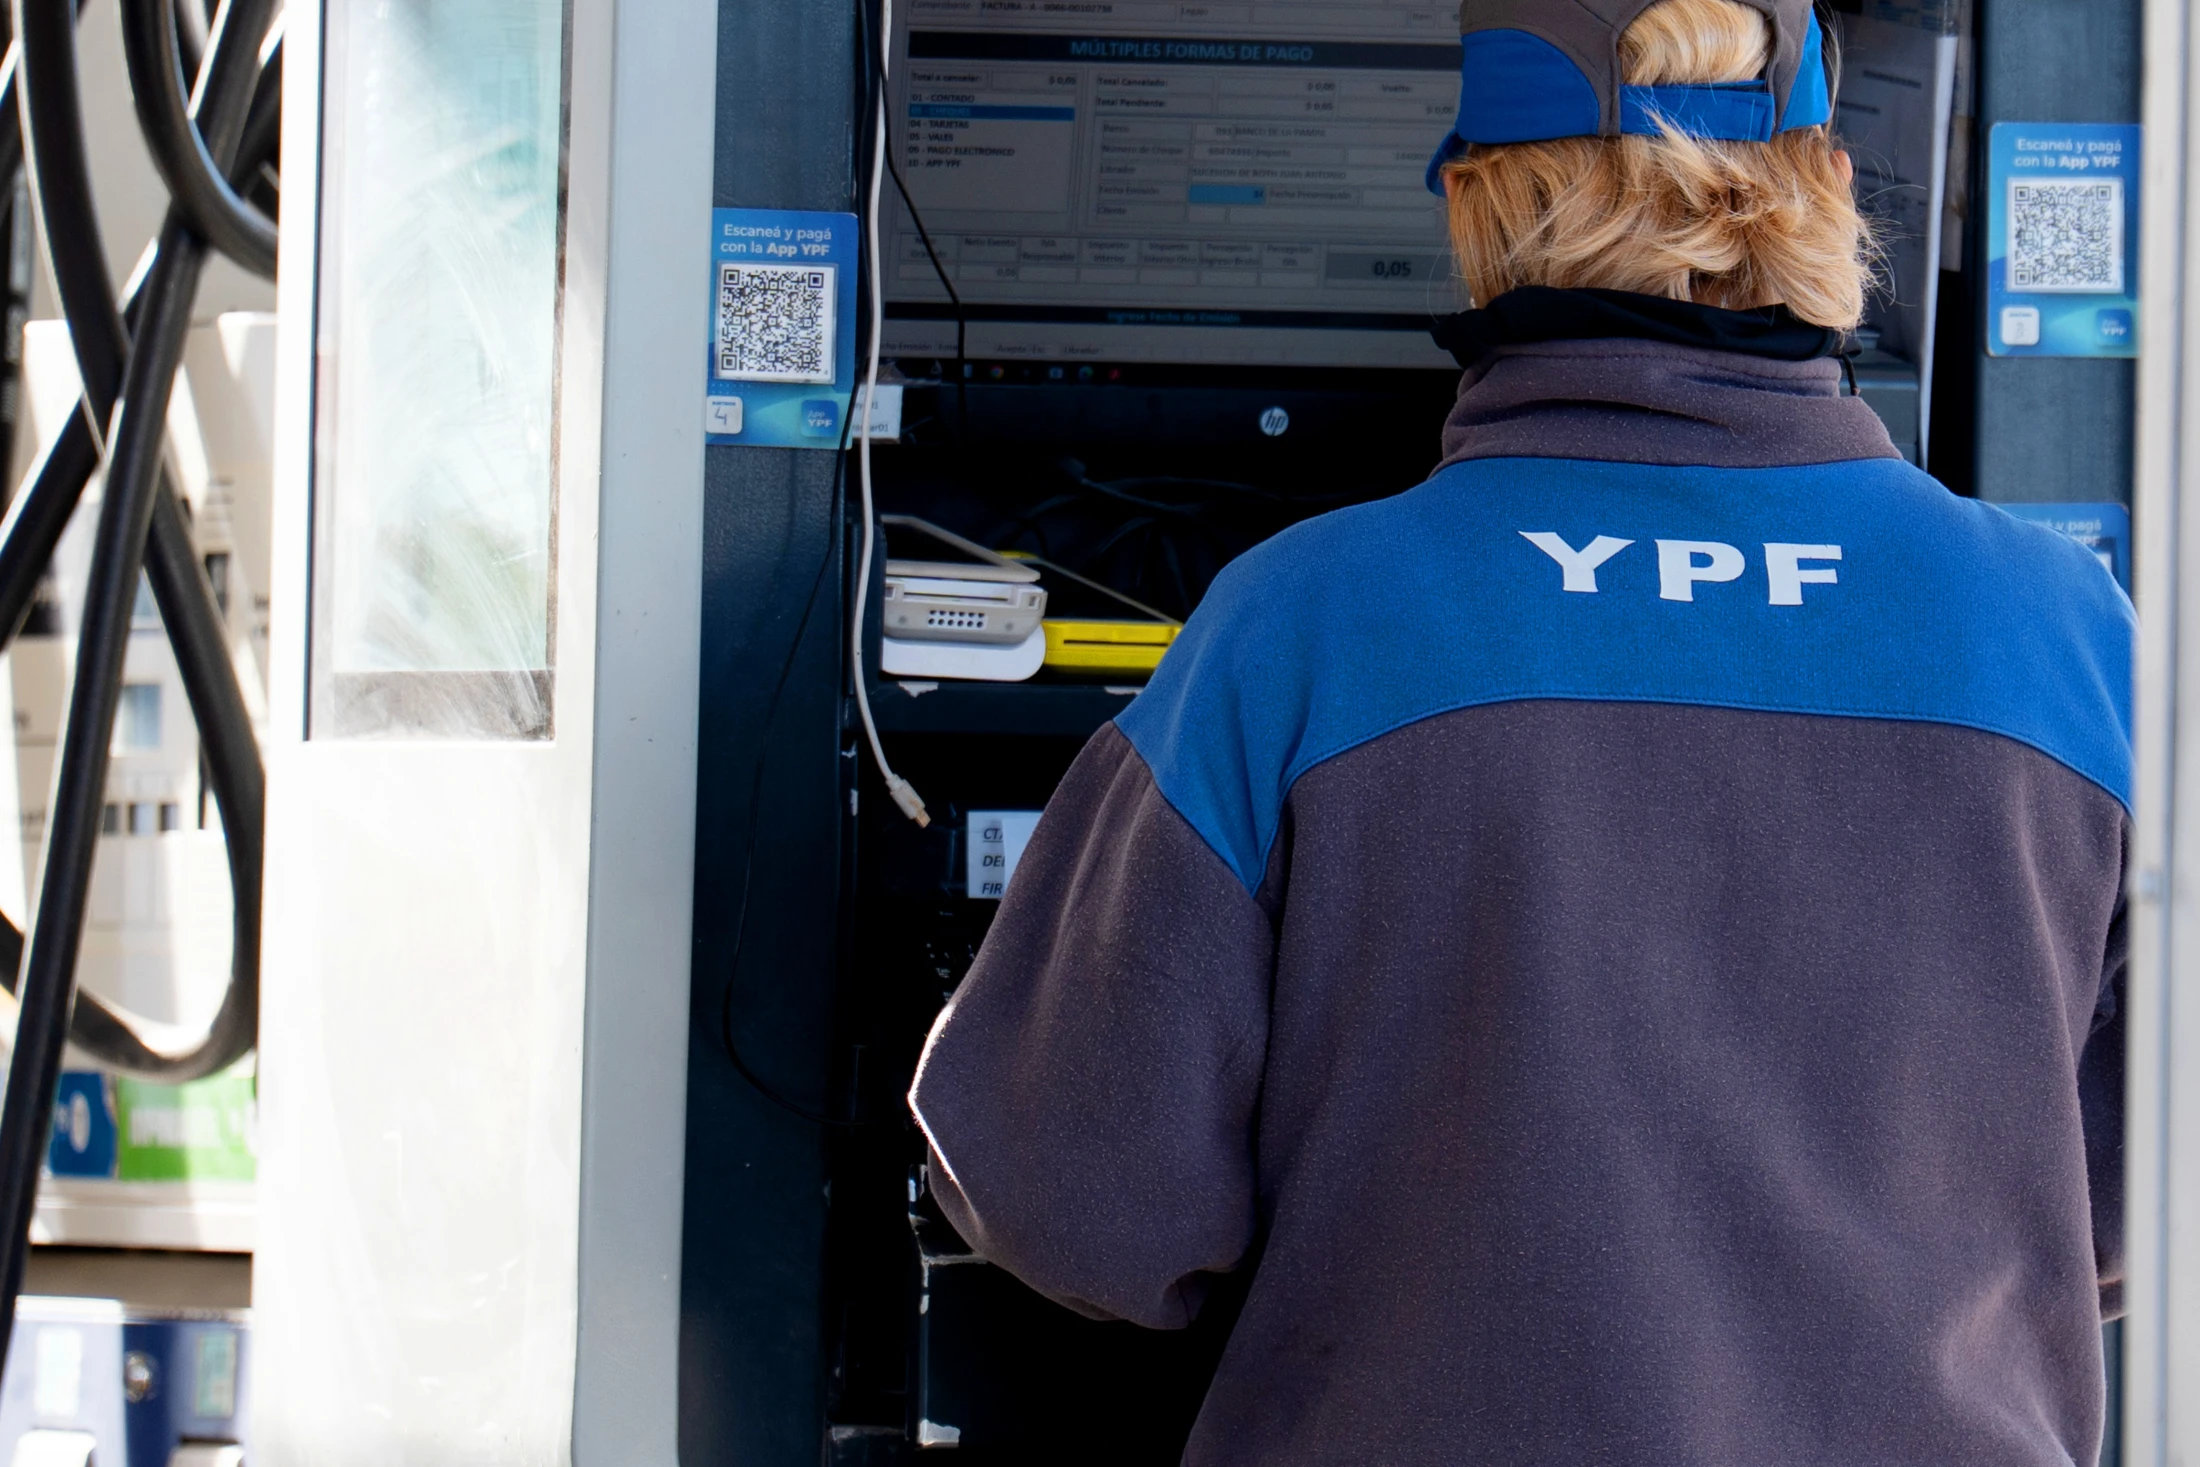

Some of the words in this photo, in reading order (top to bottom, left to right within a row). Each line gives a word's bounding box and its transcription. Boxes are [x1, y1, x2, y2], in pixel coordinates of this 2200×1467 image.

[1071, 39, 1161, 58] MÚLTIPLES
[1166, 43, 1235, 60] FORMAS
[1240, 45, 1261, 60] DE
[1267, 46, 1313, 62] PAGO
[1097, 77, 1120, 85] Total
[930, 94, 975, 103] CONTADO
[1096, 98, 1118, 107] Total
[929, 121, 969, 129] TARJETAS
[928, 133, 954, 142] VALES
[927, 147, 952, 155] PAGO
[954, 147, 1015, 156] ELECTRONICO
[2017, 138, 2073, 151] Escaneá
[2075, 142, 2085, 154] y
[2088, 139, 2122, 154] pagá
[926, 159, 943, 168] APP
[2014, 156, 2039, 167] con
[2044, 155, 2056, 168] la
[2059, 155, 2089, 170] App
[2092, 156, 2121, 168] YPF
[724, 223, 781, 238] Escaneá
[784, 229, 793, 241] y
[796, 228, 832, 243] pagá
[720, 242, 746, 253] con
[751, 241, 763, 254] la
[767, 242, 798, 257] App
[802, 243, 830, 257] YPF
[1373, 261, 1411, 279] 0,05
[714, 406, 728, 426] 4
[808, 418, 833, 428] YPF
[1262, 408, 1288, 436] hp
[1520, 531, 1843, 606] YPF
[983, 827, 1003, 842] CT
